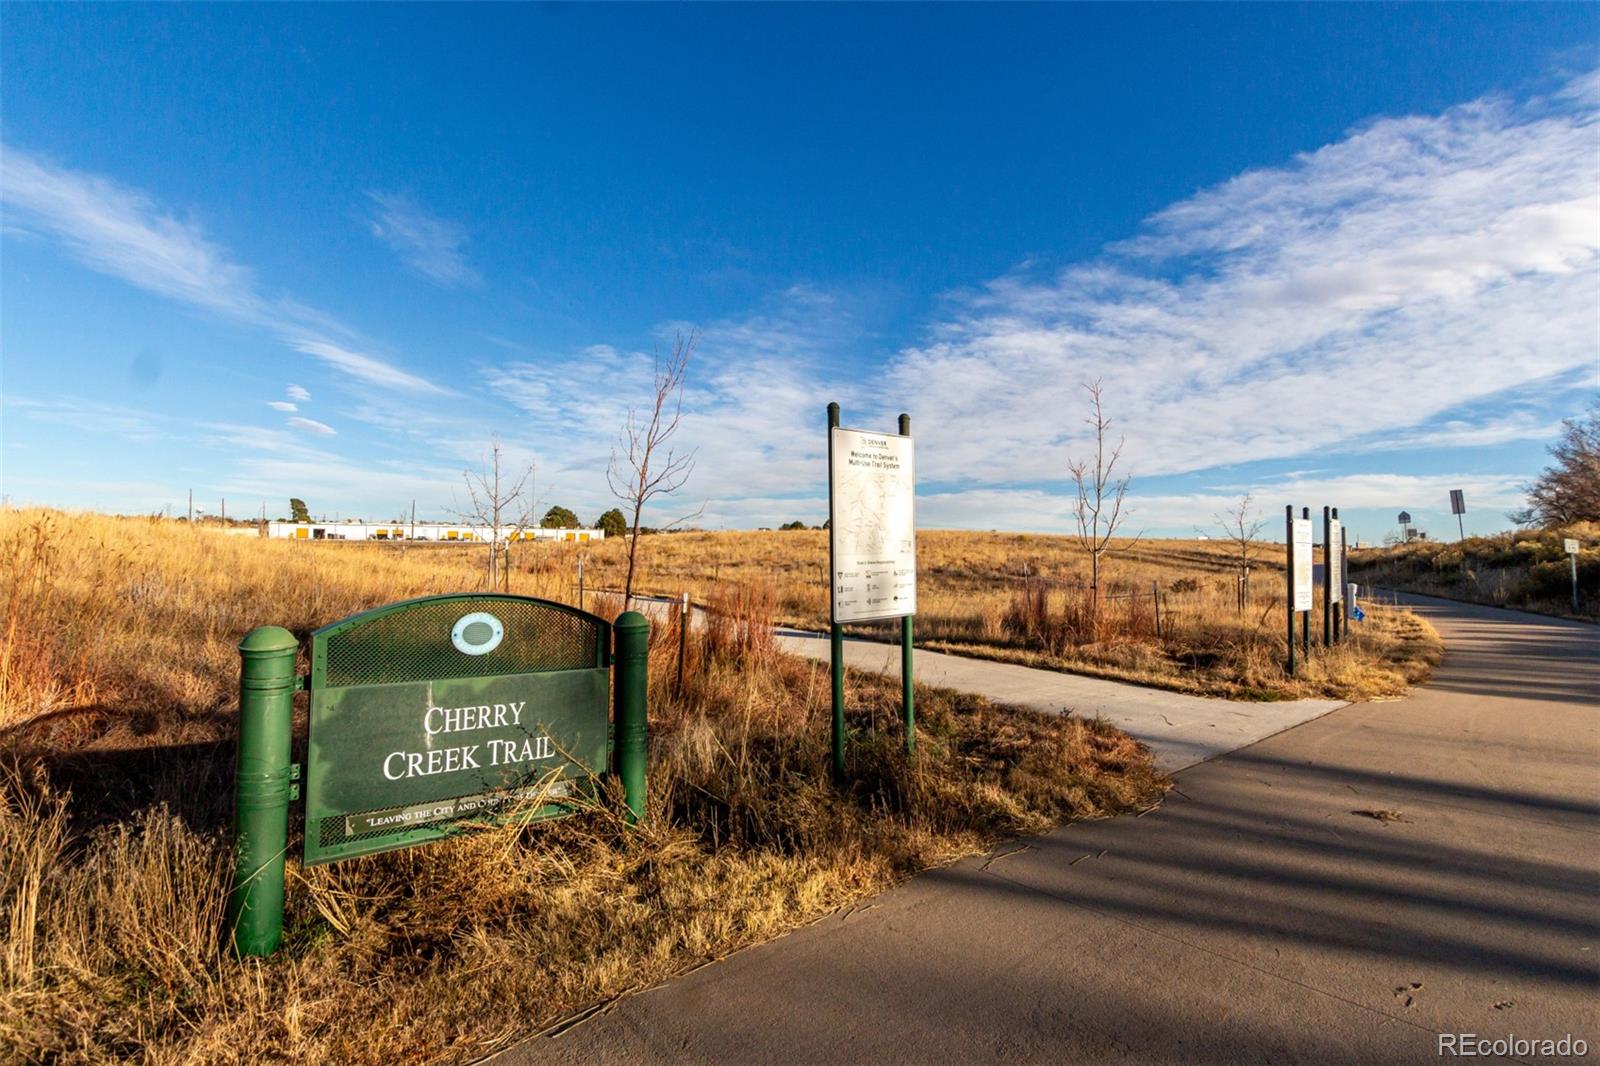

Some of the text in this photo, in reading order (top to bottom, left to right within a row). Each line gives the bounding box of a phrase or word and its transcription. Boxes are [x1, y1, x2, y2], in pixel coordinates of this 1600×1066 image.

[851, 451, 871, 459] Welcome
[883, 461, 900, 470] System
[423, 701, 526, 735] CHERRY
[383, 736, 556, 781] CREEK TRAIL
[414, 810, 431, 819] THE
[433, 805, 455, 816] CITY
[457, 802, 476, 812] AND
